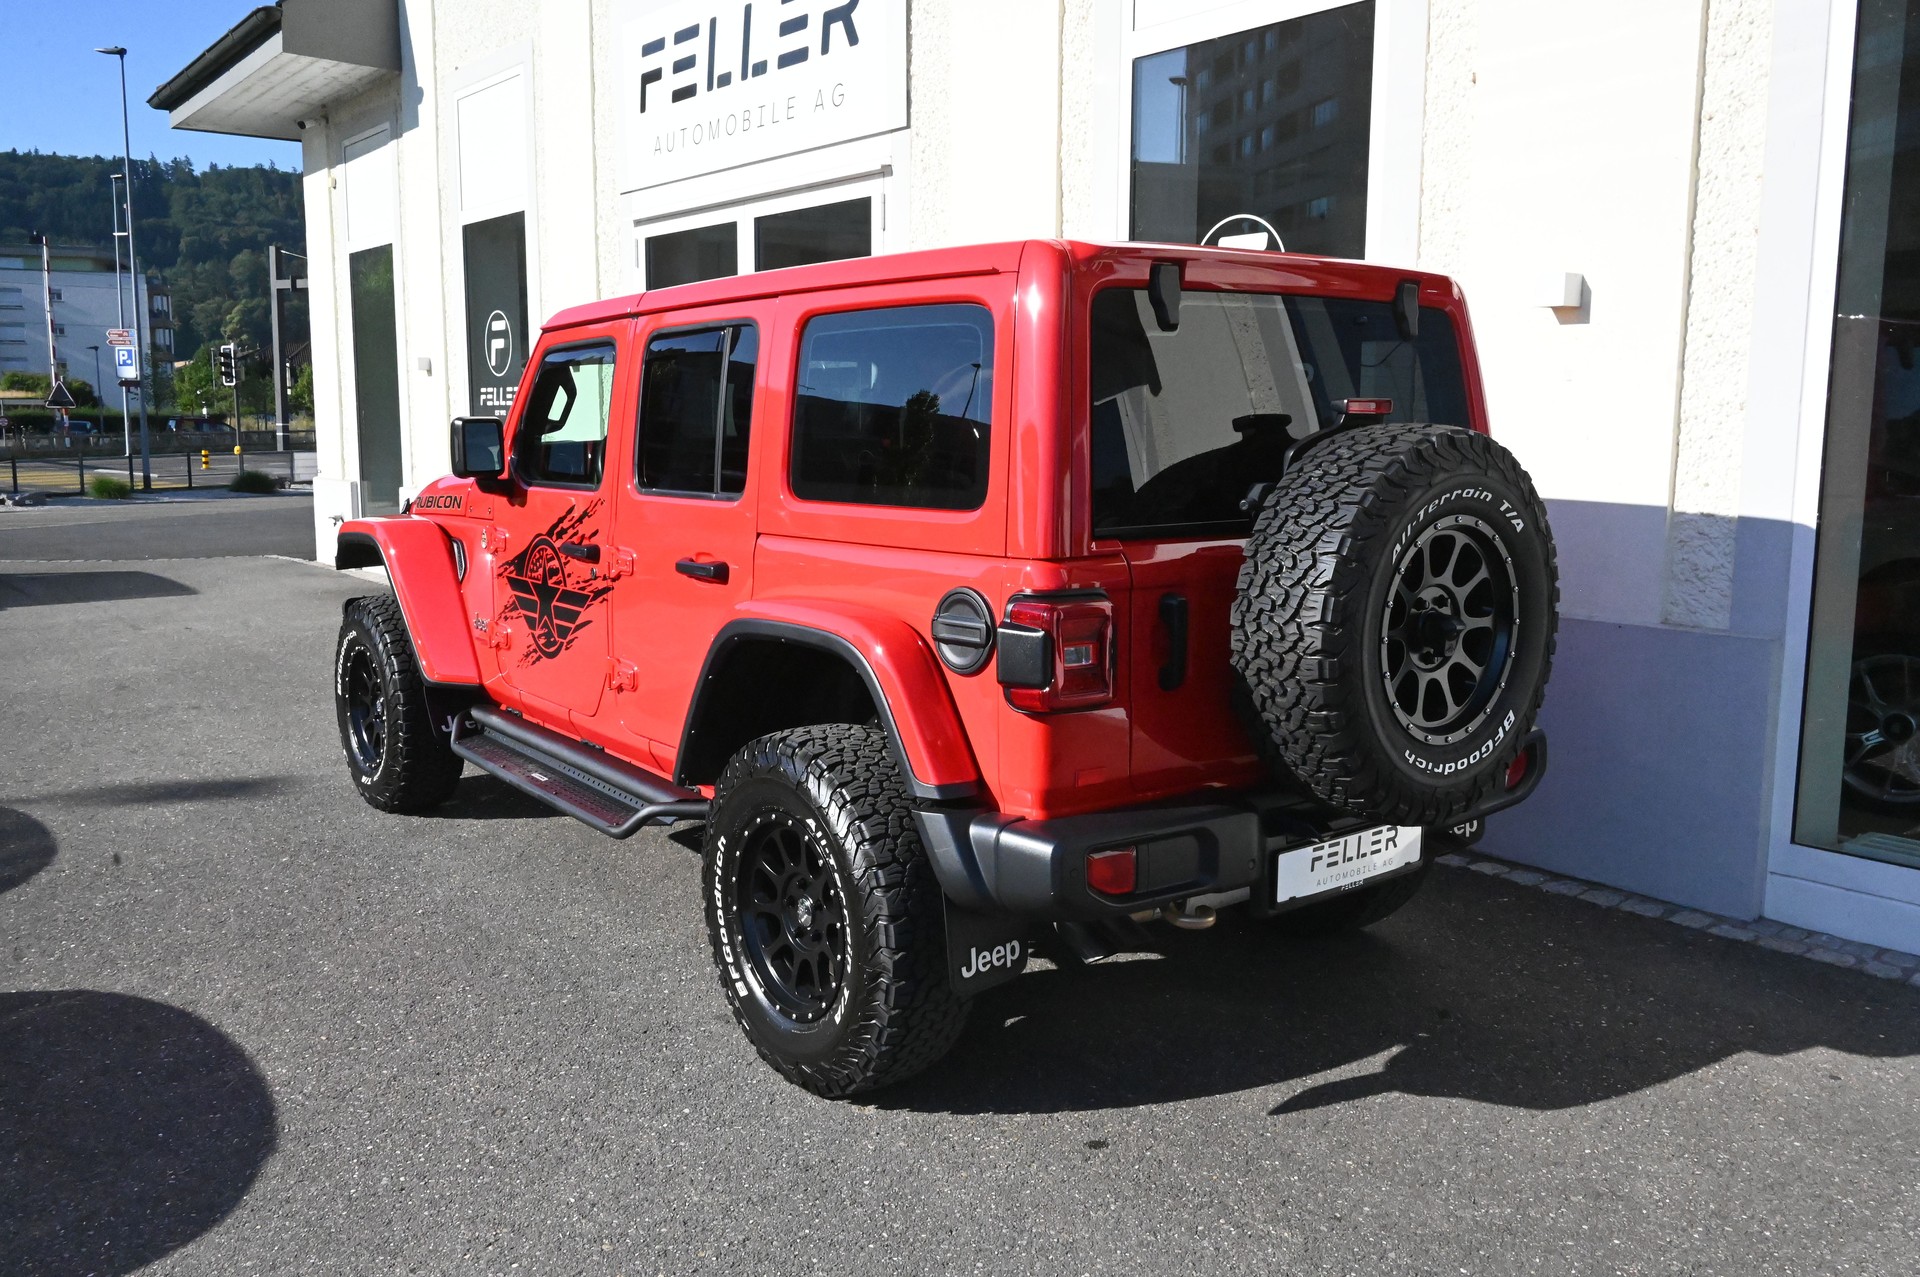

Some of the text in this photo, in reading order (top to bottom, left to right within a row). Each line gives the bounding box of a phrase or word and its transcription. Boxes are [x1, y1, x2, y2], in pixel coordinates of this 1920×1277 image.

[640, 0, 860, 114] FELLER
[653, 82, 846, 157] AUTOMOBILE AG
[118, 350, 128, 365] P
[416, 495, 463, 509] RUBICON
[1391, 486, 1526, 567] All-Terrain T/A
[1404, 708, 1517, 776] BFGoodrich
[1310, 825, 1399, 873] FELLER
[1316, 857, 1395, 888] AUTOMOBILE AG
[713, 835, 750, 998] BFGoodrich
[961, 939, 1021, 979] Jeep
